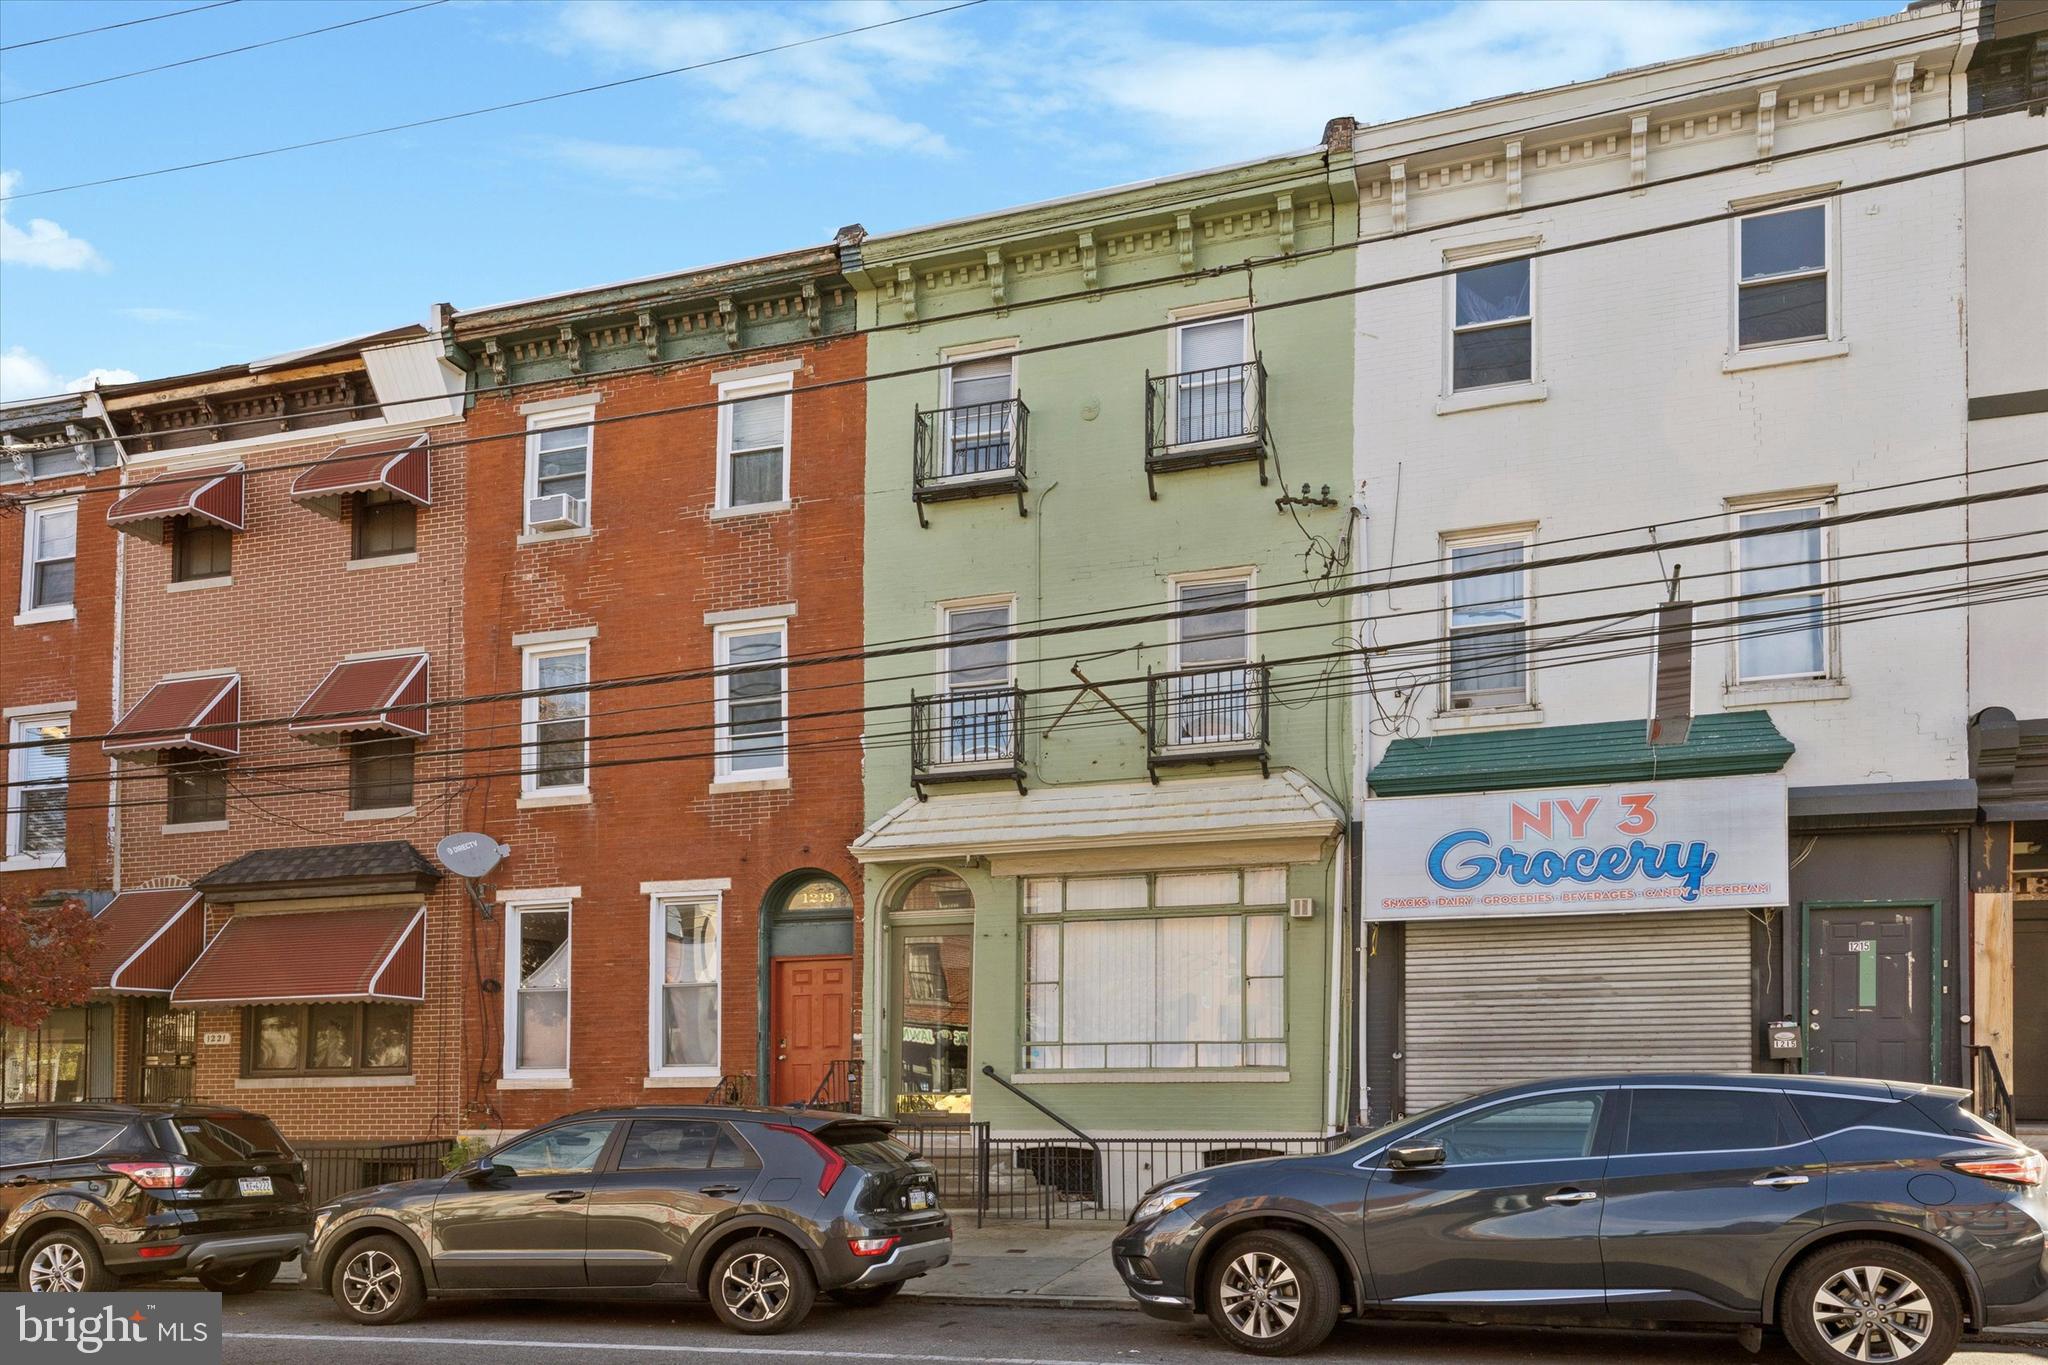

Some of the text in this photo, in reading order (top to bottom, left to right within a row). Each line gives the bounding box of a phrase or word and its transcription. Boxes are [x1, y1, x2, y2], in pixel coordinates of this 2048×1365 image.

[1510, 793, 1656, 841] NY 3
[453, 839, 478, 853] DIRECTV
[1427, 828, 1717, 902] Grocery
[802, 892, 835, 903] 1219
[1382, 883, 1770, 909] SNACKS DAIRY GROCERIES BEVERAGES CANDY ICECREAM
[1849, 941, 1871, 951] 1215
[207, 1034, 226, 1043] 1221
[1774, 1040, 1797, 1049] 1215
